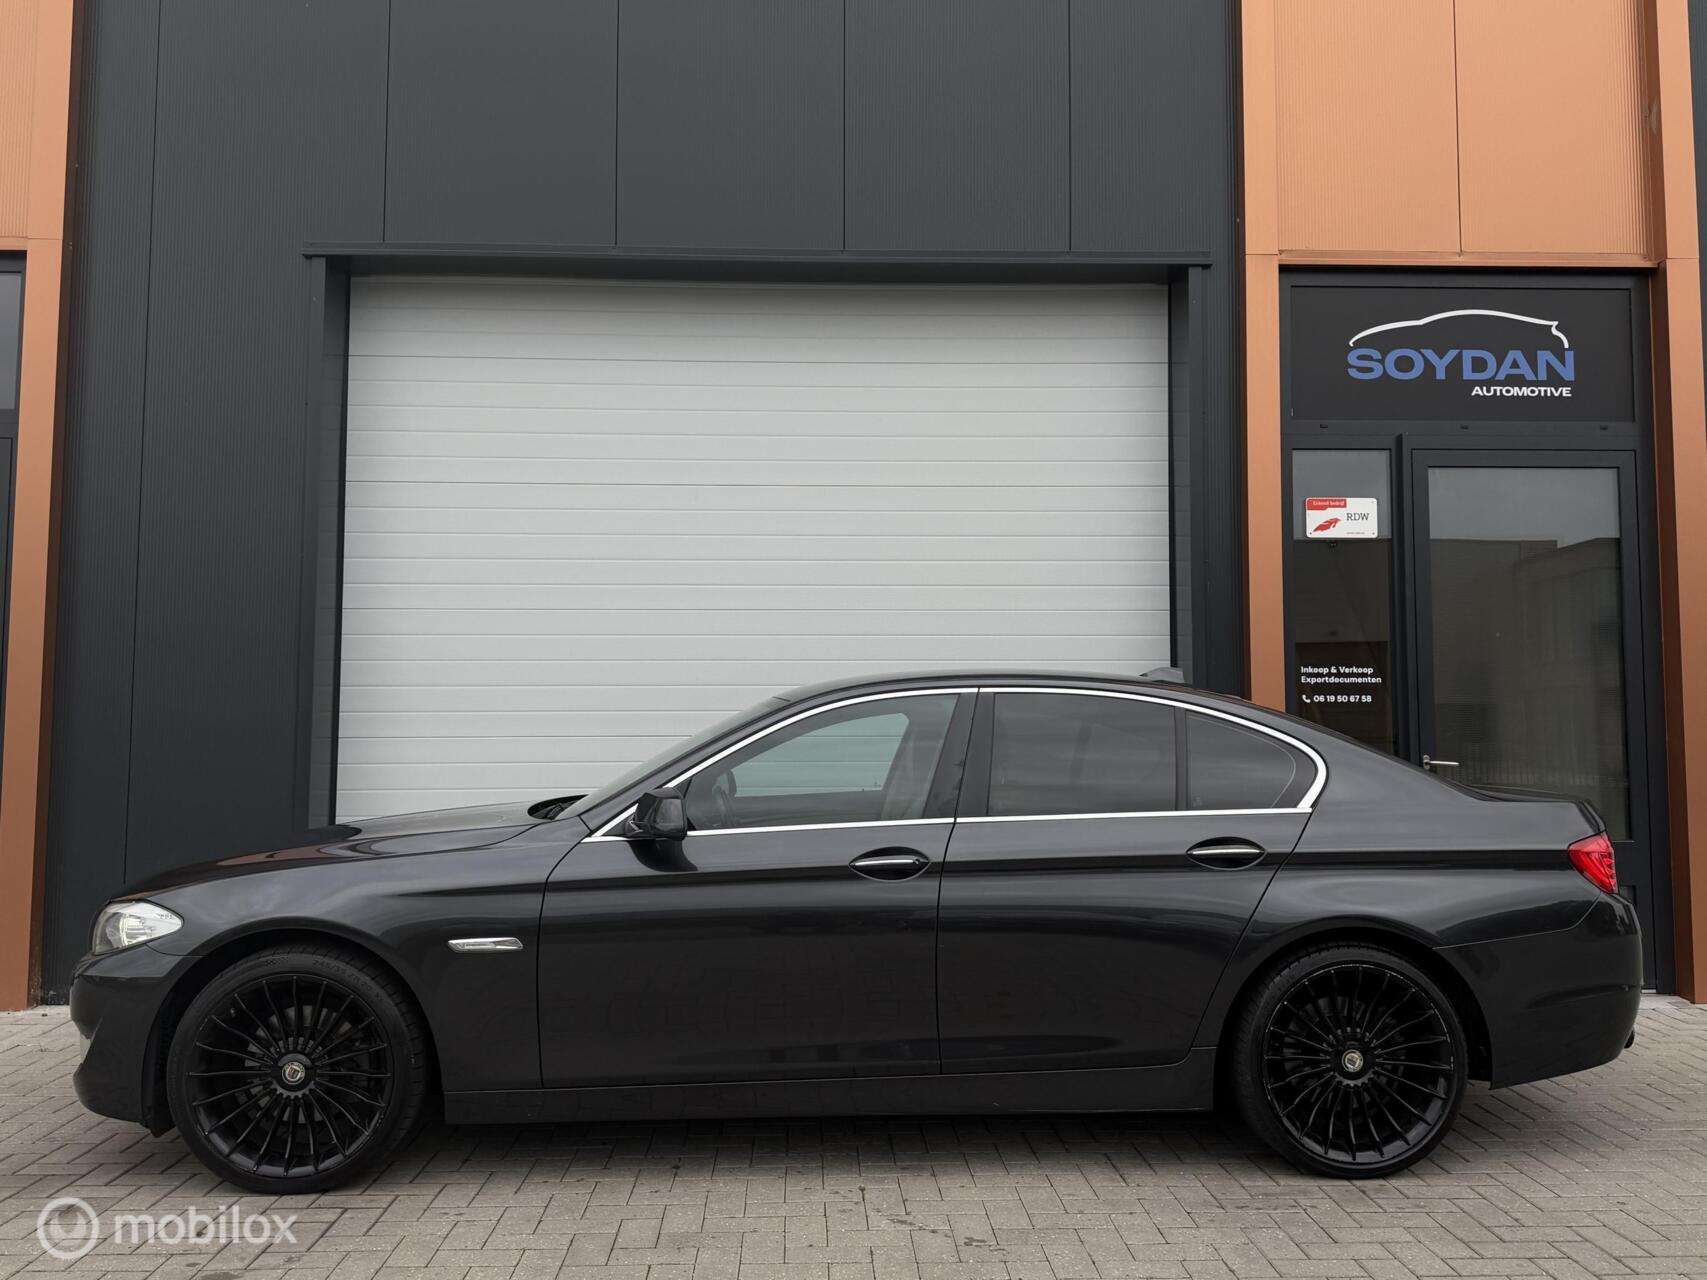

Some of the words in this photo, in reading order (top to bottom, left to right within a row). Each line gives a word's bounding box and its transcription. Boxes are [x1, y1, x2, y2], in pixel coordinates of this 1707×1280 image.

[1347, 348, 1575, 381] SOYDAN
[1471, 386, 1571, 397] AUTOMOTIVE
[1346, 512, 1369, 521] RDW
[1301, 666, 1329, 674] Inkoop
[1330, 666, 1338, 674] &
[1339, 666, 1373, 674] Verkoop
[1301, 676, 1382, 684] Exportdocumenten
